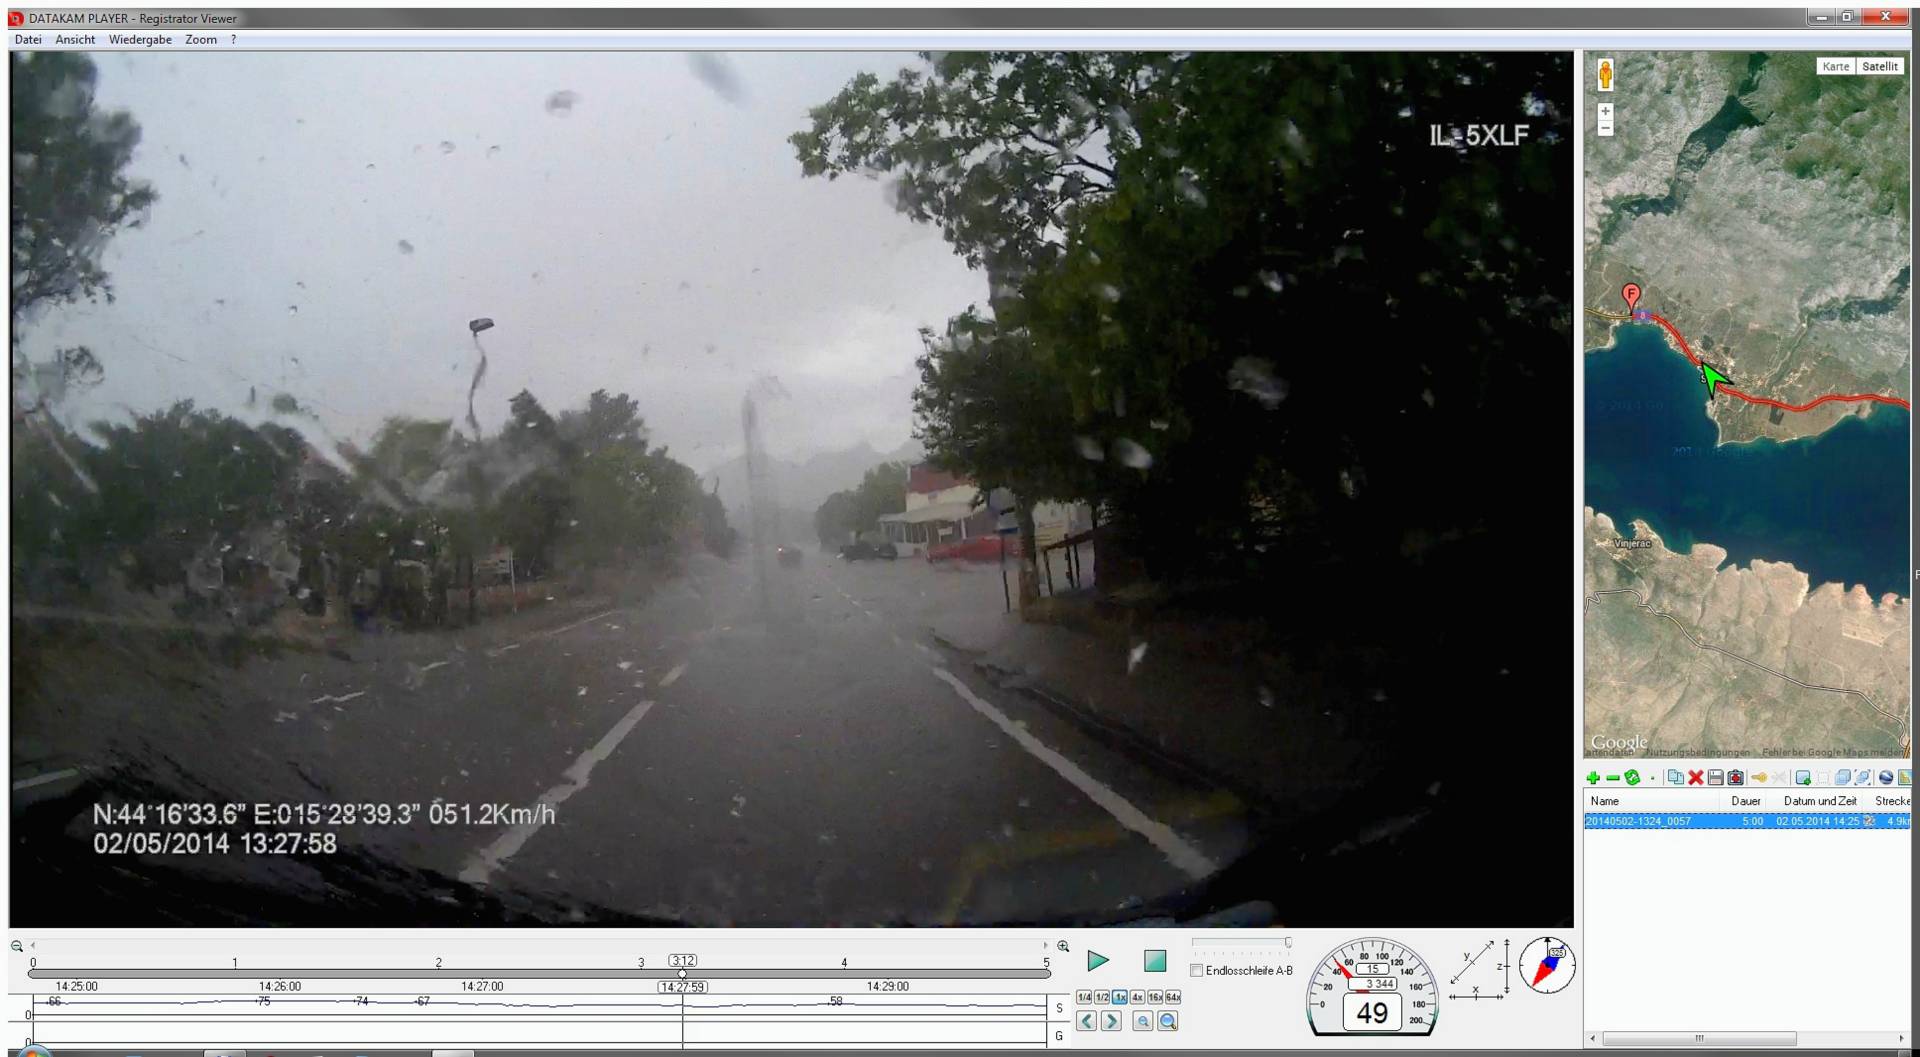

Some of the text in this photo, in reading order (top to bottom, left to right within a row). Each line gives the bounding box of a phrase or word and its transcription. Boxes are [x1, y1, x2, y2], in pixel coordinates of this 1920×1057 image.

[29, 14, 85, 24] DATAKAM
[88, 14, 129, 24] PLAYER
[139, 14, 198, 26] Registrator
[201, 14, 237, 24] Viewer
[15, 34, 236, 47] Datei Ansicht Wiedergabe Zoom ?
[1823, 61, 1850, 71] Karte
[1862, 61, 1898, 71] Satellit
[1628, 288, 1635, 299] F
[1614, 538, 1652, 549] Vinjerac
[1591, 734, 1649, 753] Google
[1646, 747, 1751, 758] Nutzungsbedingungen
[1762, 748, 1791, 757] Fehler
[1808, 748, 1842, 759] Google
[1843, 748, 1869, 759] Maps
[1591, 795, 1619, 806] Name
[1732, 795, 1761, 806] Dauer
[1784, 795, 1857, 806] Datum und Zeit
[1585, 816, 1692, 827] 20140502-1324_0057
[1743, 816, 1763, 826] 5:00
[1776, 816, 1860, 826] 02.05.2014 14:25
[672, 955, 694, 966] 3:12
[1359, 952, 1369, 960] 80
[1375, 952, 1389, 960] 100
[1464, 952, 1470, 962] y
[30, 957, 37, 967] 0
[435, 957, 442, 967] 2
[638, 957, 645, 967] 3
[841, 957, 848, 967] 4
[1043, 957, 1050, 967] 5
[1206, 964, 1293, 976] Endlosschleife A-B
[1332, 968, 1341, 976] 40
[1367, 965, 1380, 974] 15
[1401, 968, 1414, 976] 140
[56, 981, 98, 991] 14:25:00
[259, 981, 301, 991] 14:26:00
[462, 981, 504, 991] 14:27:00
[661, 981, 704, 992] 14:27:59
[867, 981, 910, 992] 14:29:00
[1078, 993, 1091, 1002] 1/4
[1097, 993, 1109, 1002] 1/2
[1116, 993, 1125, 1002] 1x
[1132, 993, 1142, 1002] 4x
[1149, 993, 1163, 1002] 16x
[1166, 993, 1181, 1002] 64x
[1056, 1003, 1063, 1014] S
[1320, 1000, 1326, 1008] 0
[1412, 1000, 1426, 1008] 180
[25, 1010, 32, 1020] 0
[1357, 1002, 1388, 1024] 49
[1055, 1031, 1063, 1041] G
